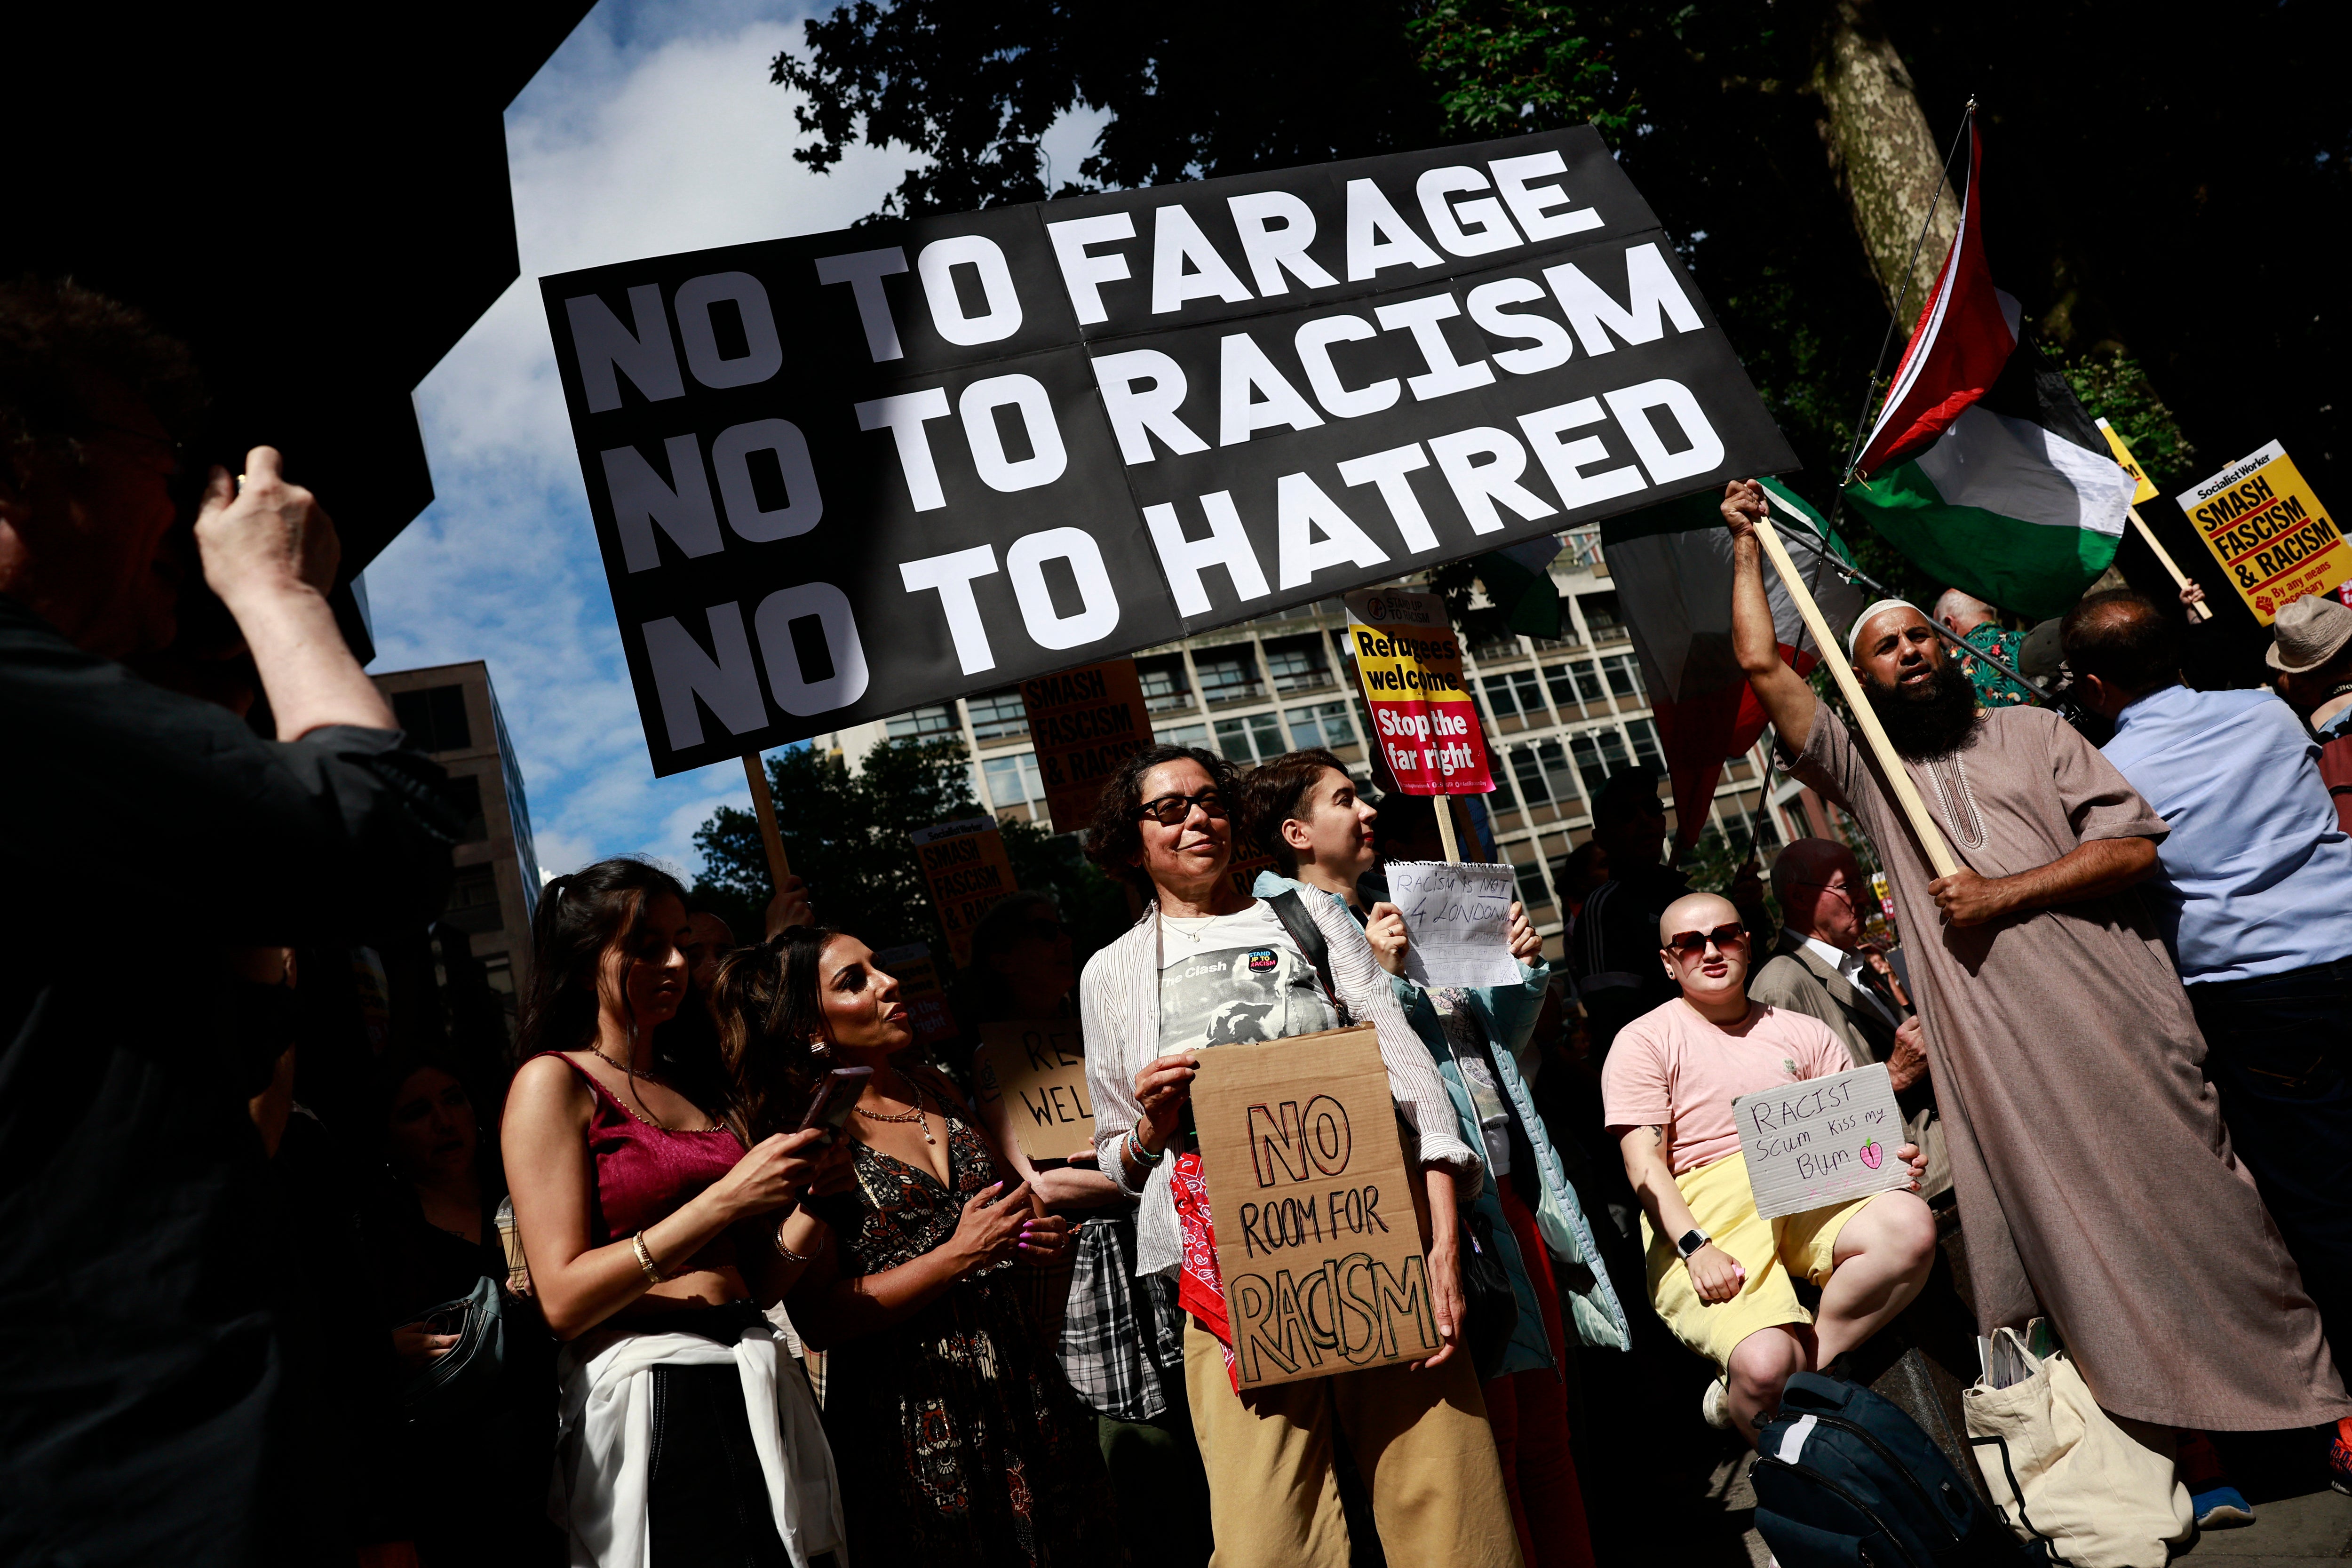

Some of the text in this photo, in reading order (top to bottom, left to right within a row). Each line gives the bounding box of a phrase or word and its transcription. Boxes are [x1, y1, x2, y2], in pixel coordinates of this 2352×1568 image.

[565, 150, 1604, 413] NO TO FARAGE
[600, 243, 1704, 573] NO TO RACISM
[2197, 454, 2270, 500] Socialist Worker
[2196, 475, 2274, 532] SMASH
[2213, 495, 2307, 561] FASCISM
[641, 378, 1725, 752] NO TO HATRED
[2234, 517, 2337, 589] & RACISM
[2271, 561, 2331, 598] By any means
[1387, 597, 1423, 611] STAND UP
[1389, 609, 1430, 624] TO RACISM
[1356, 631, 1456, 664] Refugees
[1026, 669, 1107, 709] SMASH
[1366, 664, 1459, 691] welcome
[1034, 703, 1134, 748] FASCISM
[1378, 708, 1468, 742] Stop the
[1045, 756, 1065, 786] &
[1388, 741, 1475, 776] far right
[923, 838, 981, 870] SMASH
[933, 865, 1002, 900] FASCISM
[945, 907, 961, 930] &
[1411, 897, 1427, 928] 4
[1185, 961, 1227, 979] Clash
[1750, 1079, 1852, 1135] RACIST
[1246, 1093, 1352, 1189] NO
[1239, 1185, 1390, 1259] ROOM FOR
[1231, 1252, 1441, 1383] RACISM
